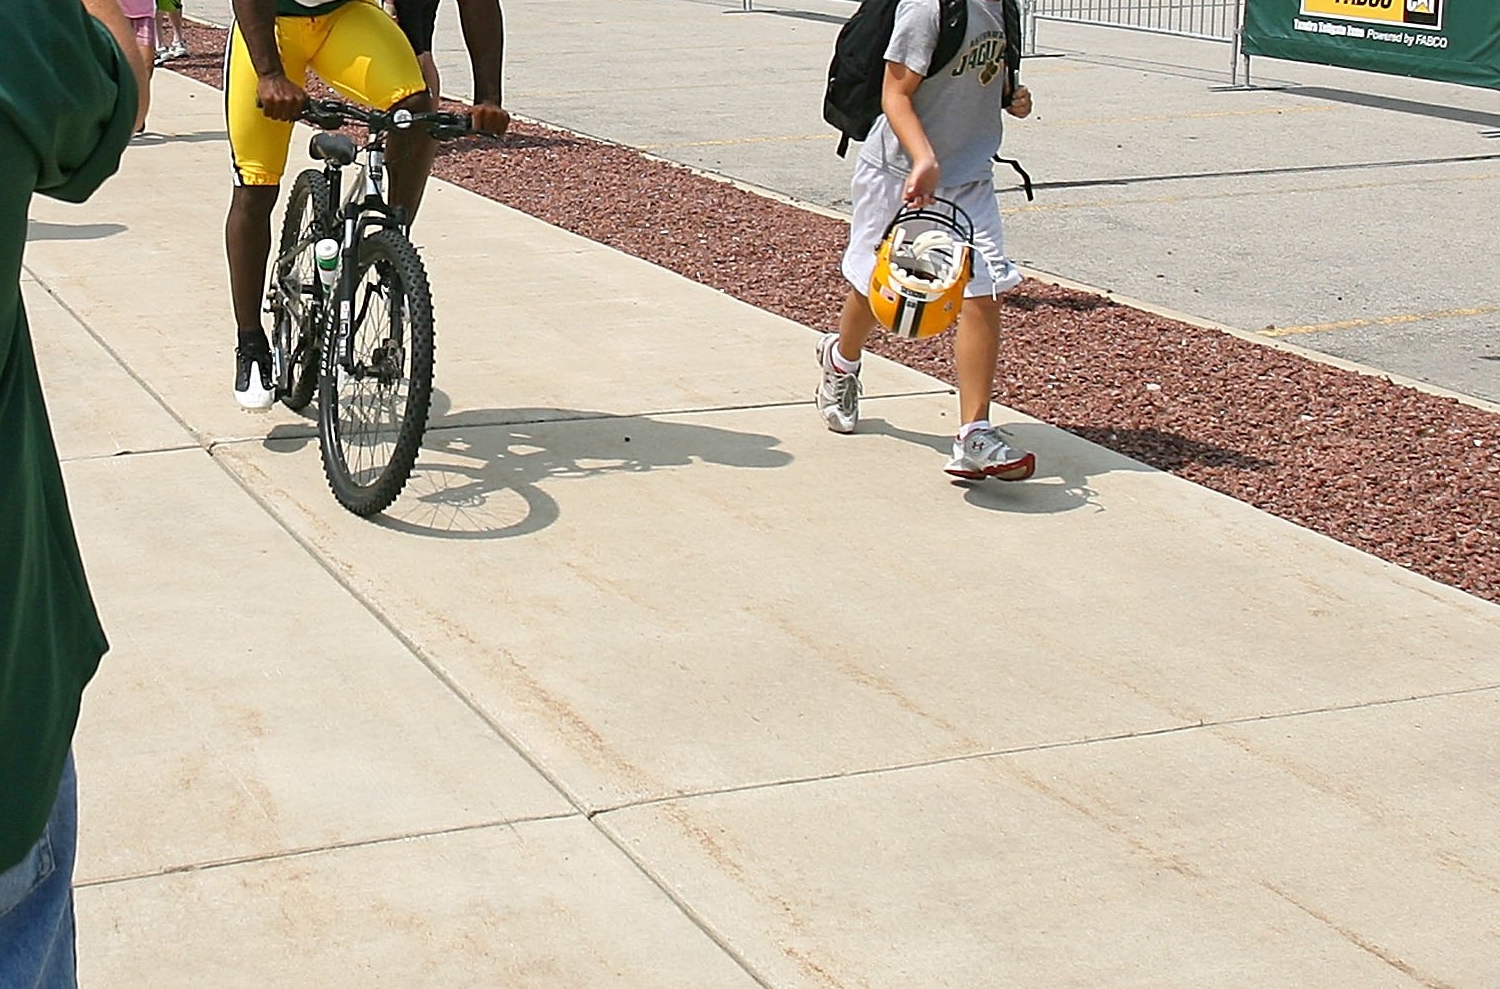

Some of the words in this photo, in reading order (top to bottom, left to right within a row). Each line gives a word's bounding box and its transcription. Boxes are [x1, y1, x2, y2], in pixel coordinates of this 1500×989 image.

[1366, 28, 1402, 43] Powered
[1403, 34, 1414, 47] by
[1415, 34, 1448, 49] FABCO
